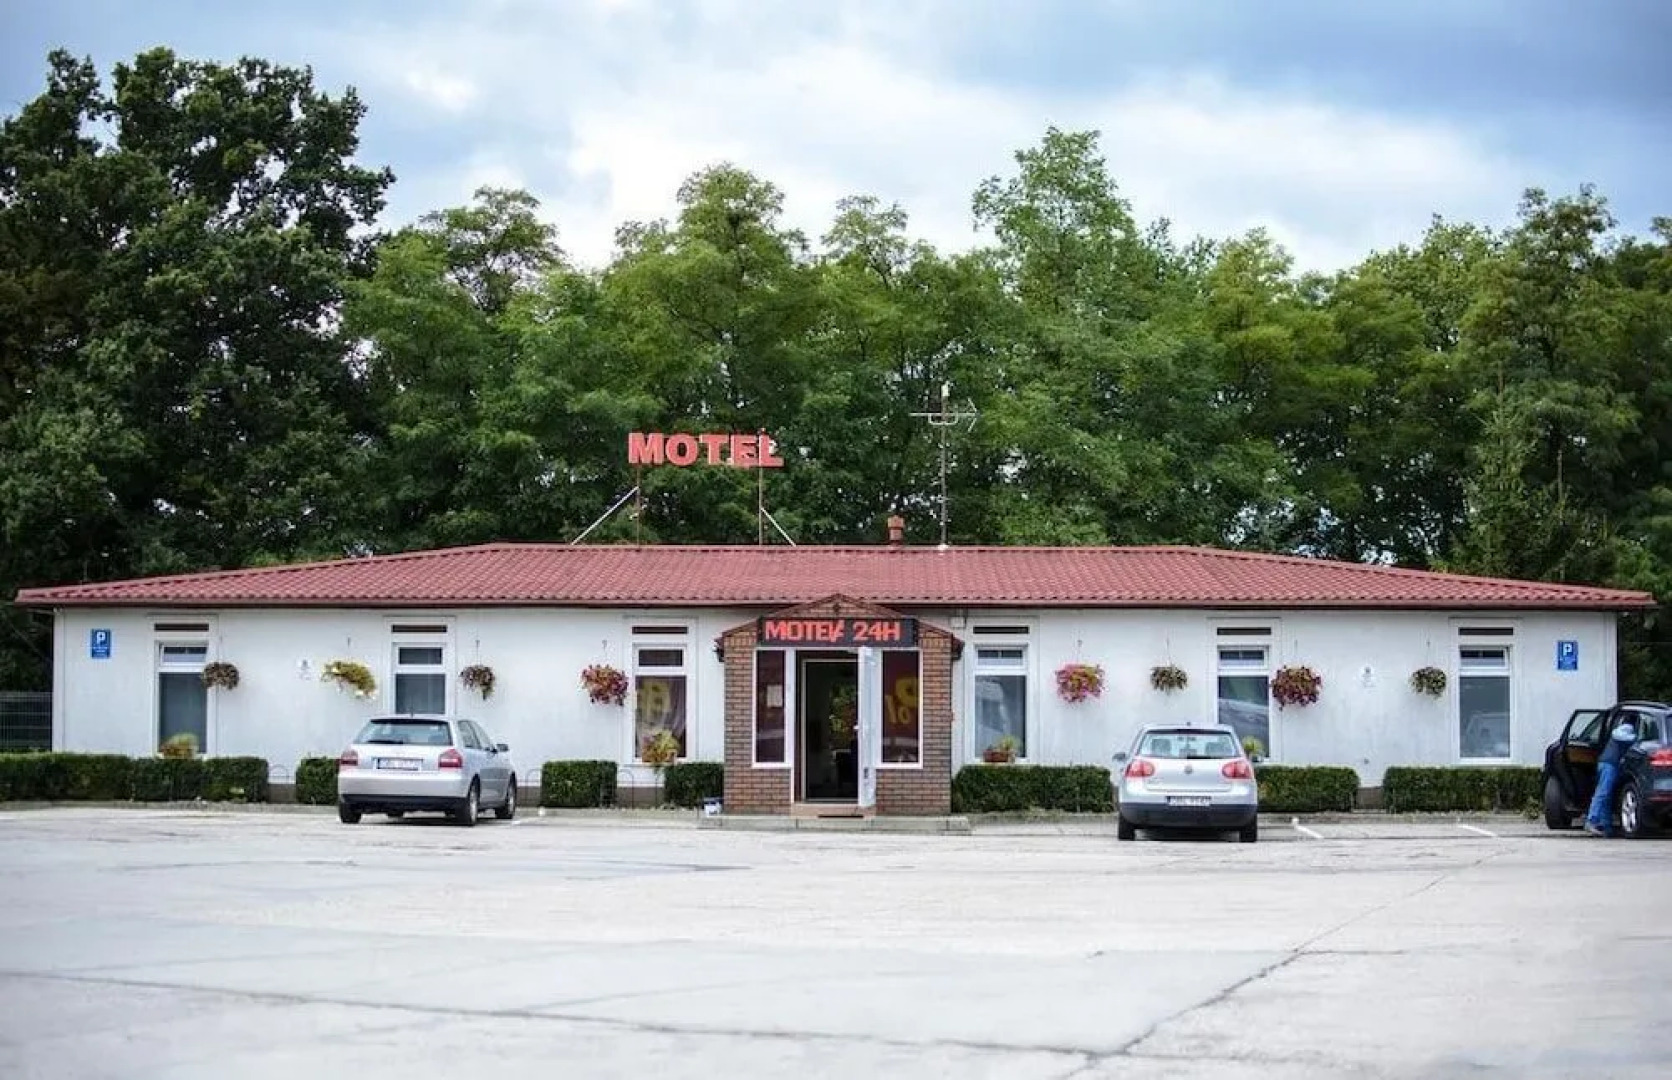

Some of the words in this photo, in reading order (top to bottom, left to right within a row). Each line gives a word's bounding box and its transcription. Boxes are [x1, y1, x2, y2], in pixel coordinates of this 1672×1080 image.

[628, 432, 784, 467] MOTEL
[96, 631, 106, 645] P
[852, 620, 900, 641] 24H
[1562, 643, 1573, 656] P
